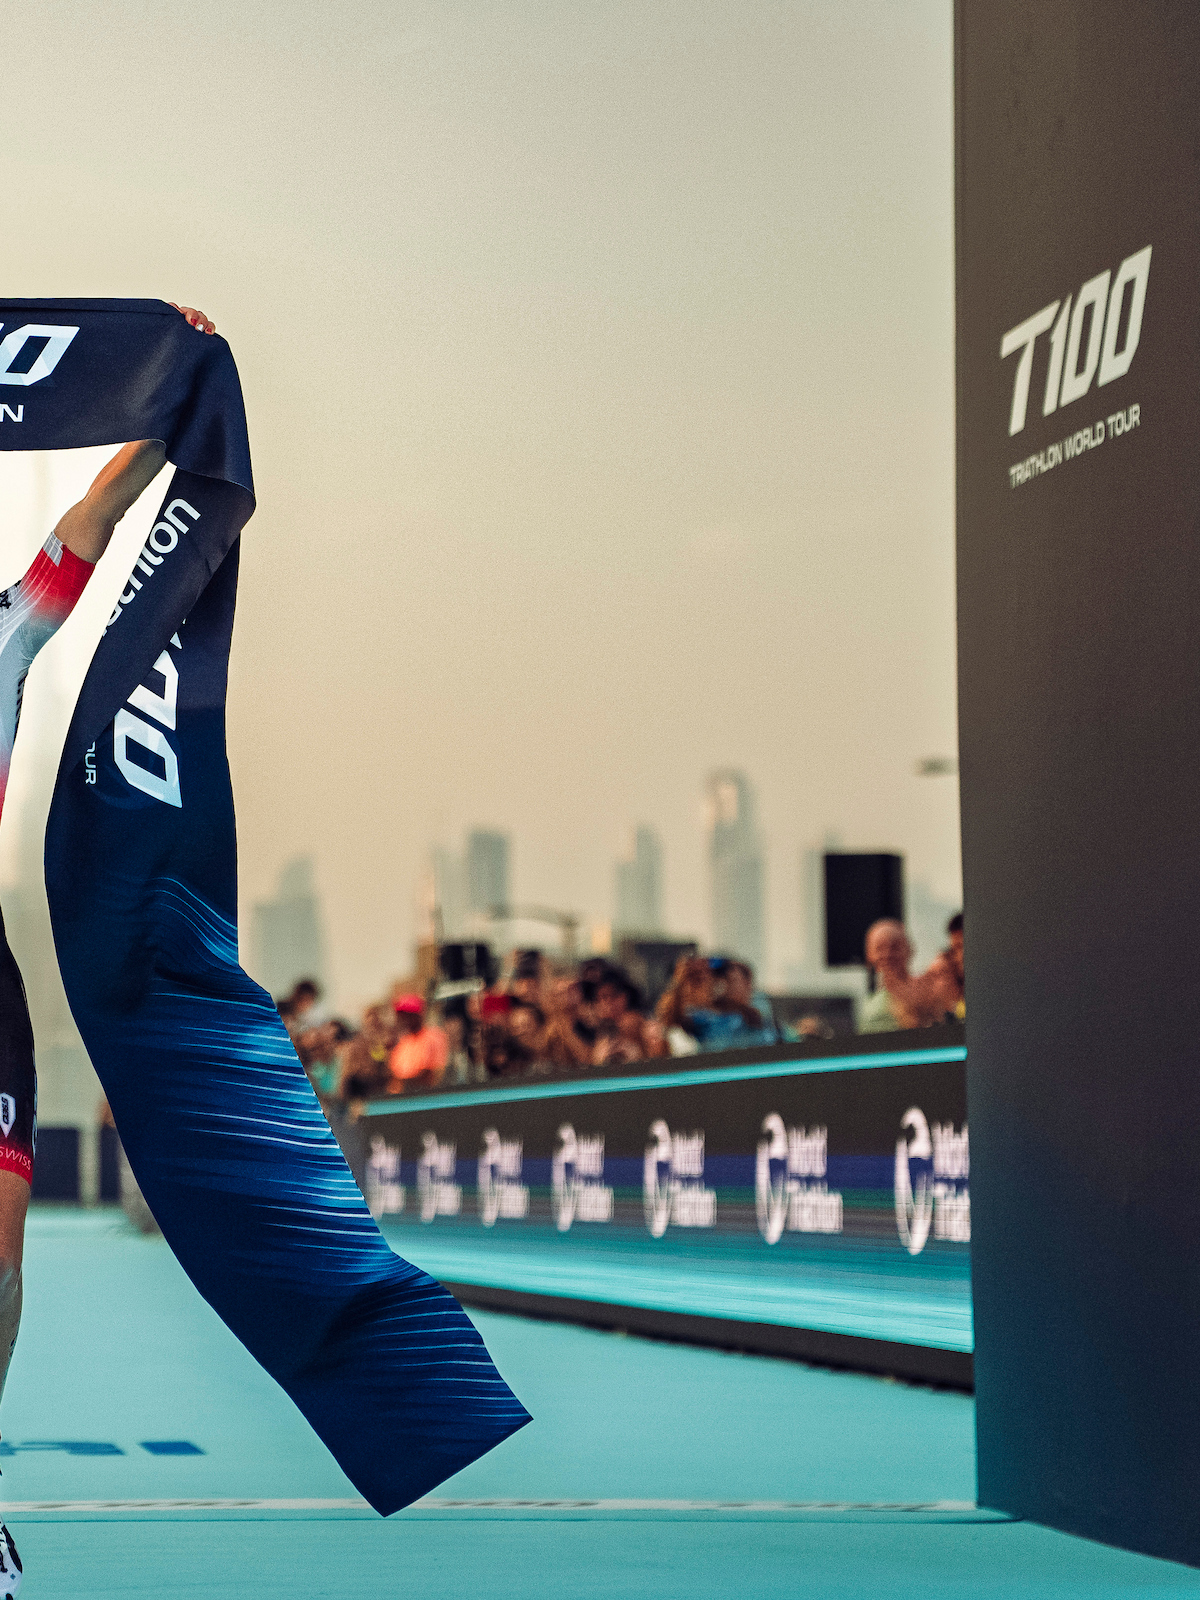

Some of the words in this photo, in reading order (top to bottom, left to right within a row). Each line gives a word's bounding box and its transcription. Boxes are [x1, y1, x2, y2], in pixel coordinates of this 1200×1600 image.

[1001, 244, 1152, 437] T100
[1009, 441, 1063, 489] TRIATHLON
[1064, 420, 1105, 460] WORLD
[1107, 403, 1141, 439] TOUR
